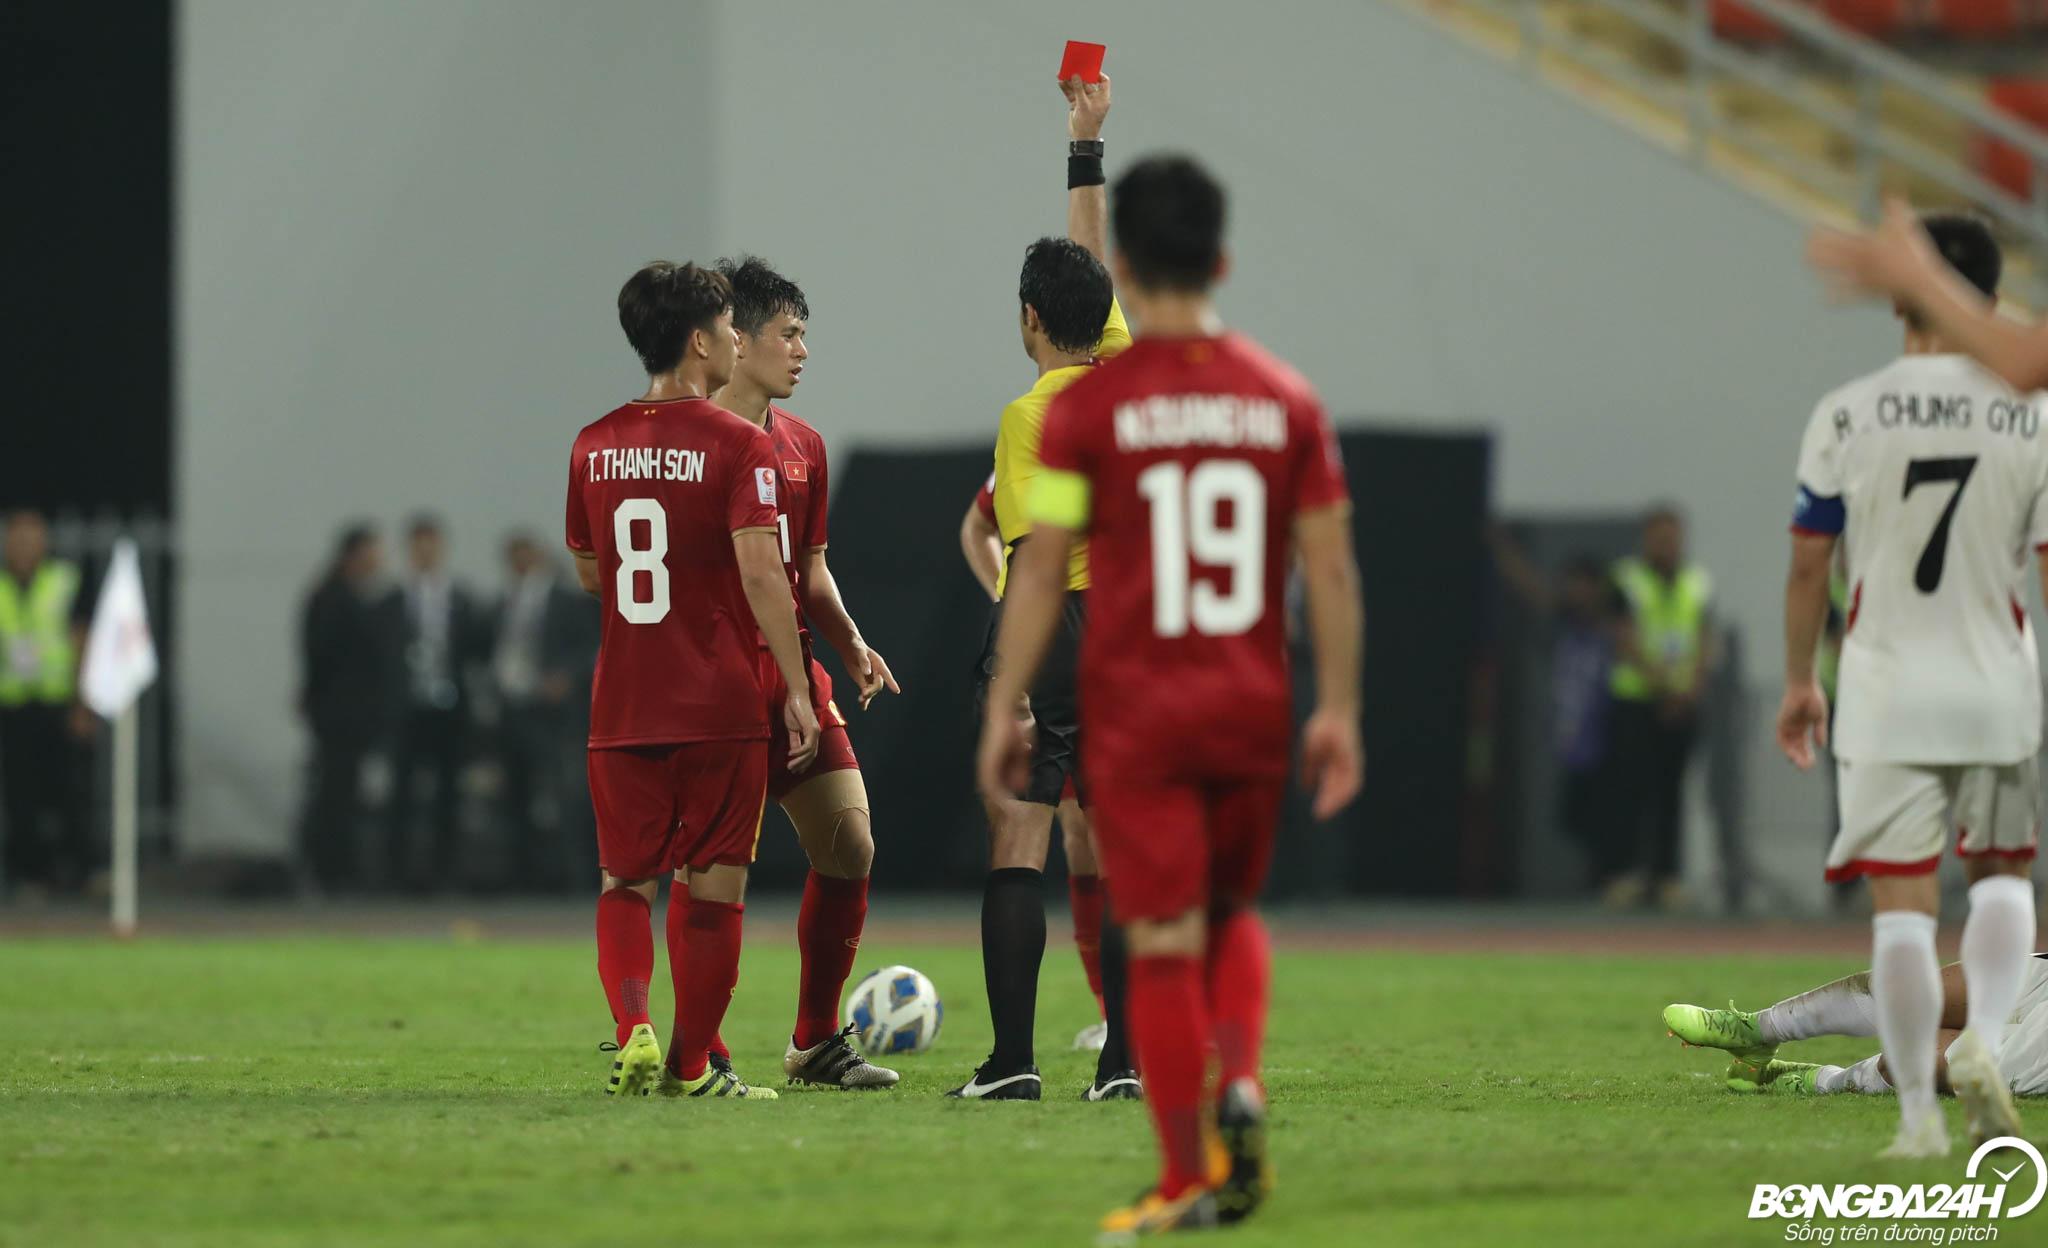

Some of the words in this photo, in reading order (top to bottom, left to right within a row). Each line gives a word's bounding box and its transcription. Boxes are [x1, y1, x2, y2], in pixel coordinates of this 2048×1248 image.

[664, 449, 705, 482] SON
[1877, 393, 1972, 428] CHUNG
[1987, 399, 2040, 440] GYU
[613, 498, 671, 624] 8
[1136, 458, 1267, 638] 19
[1902, 455, 1979, 595] 7
